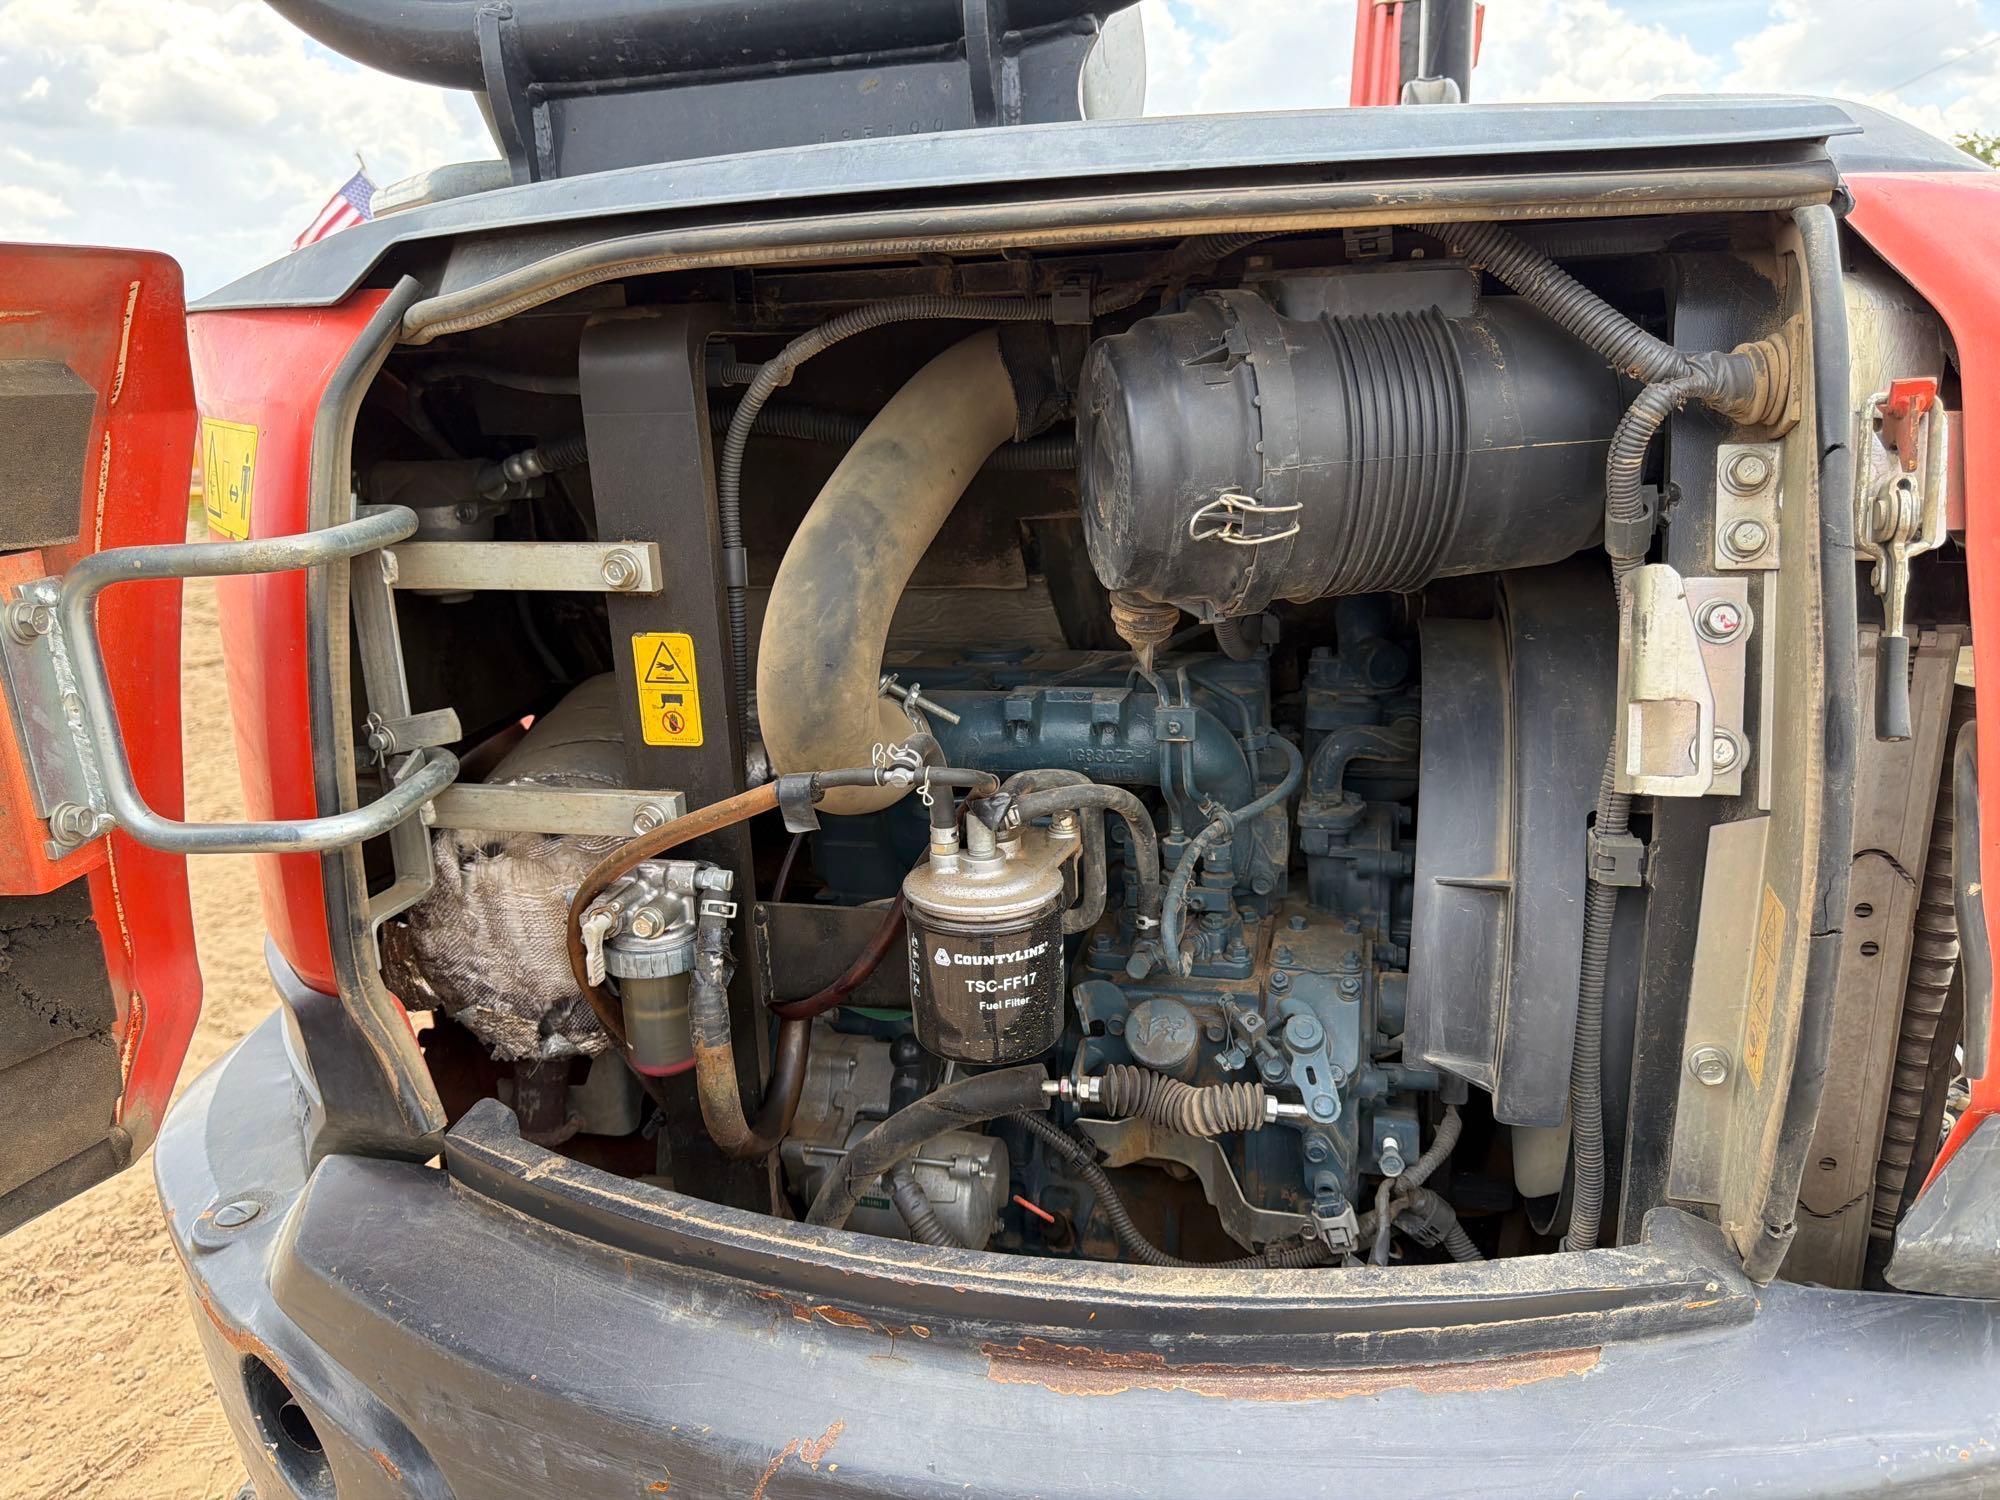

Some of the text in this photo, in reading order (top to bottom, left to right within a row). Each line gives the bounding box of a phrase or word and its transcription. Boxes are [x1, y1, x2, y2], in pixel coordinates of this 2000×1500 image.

[953, 943, 1045, 966] COUNTYLINE
[964, 971, 1037, 993] TSC-FF17
[979, 996, 1031, 1011] Fuel Filter
